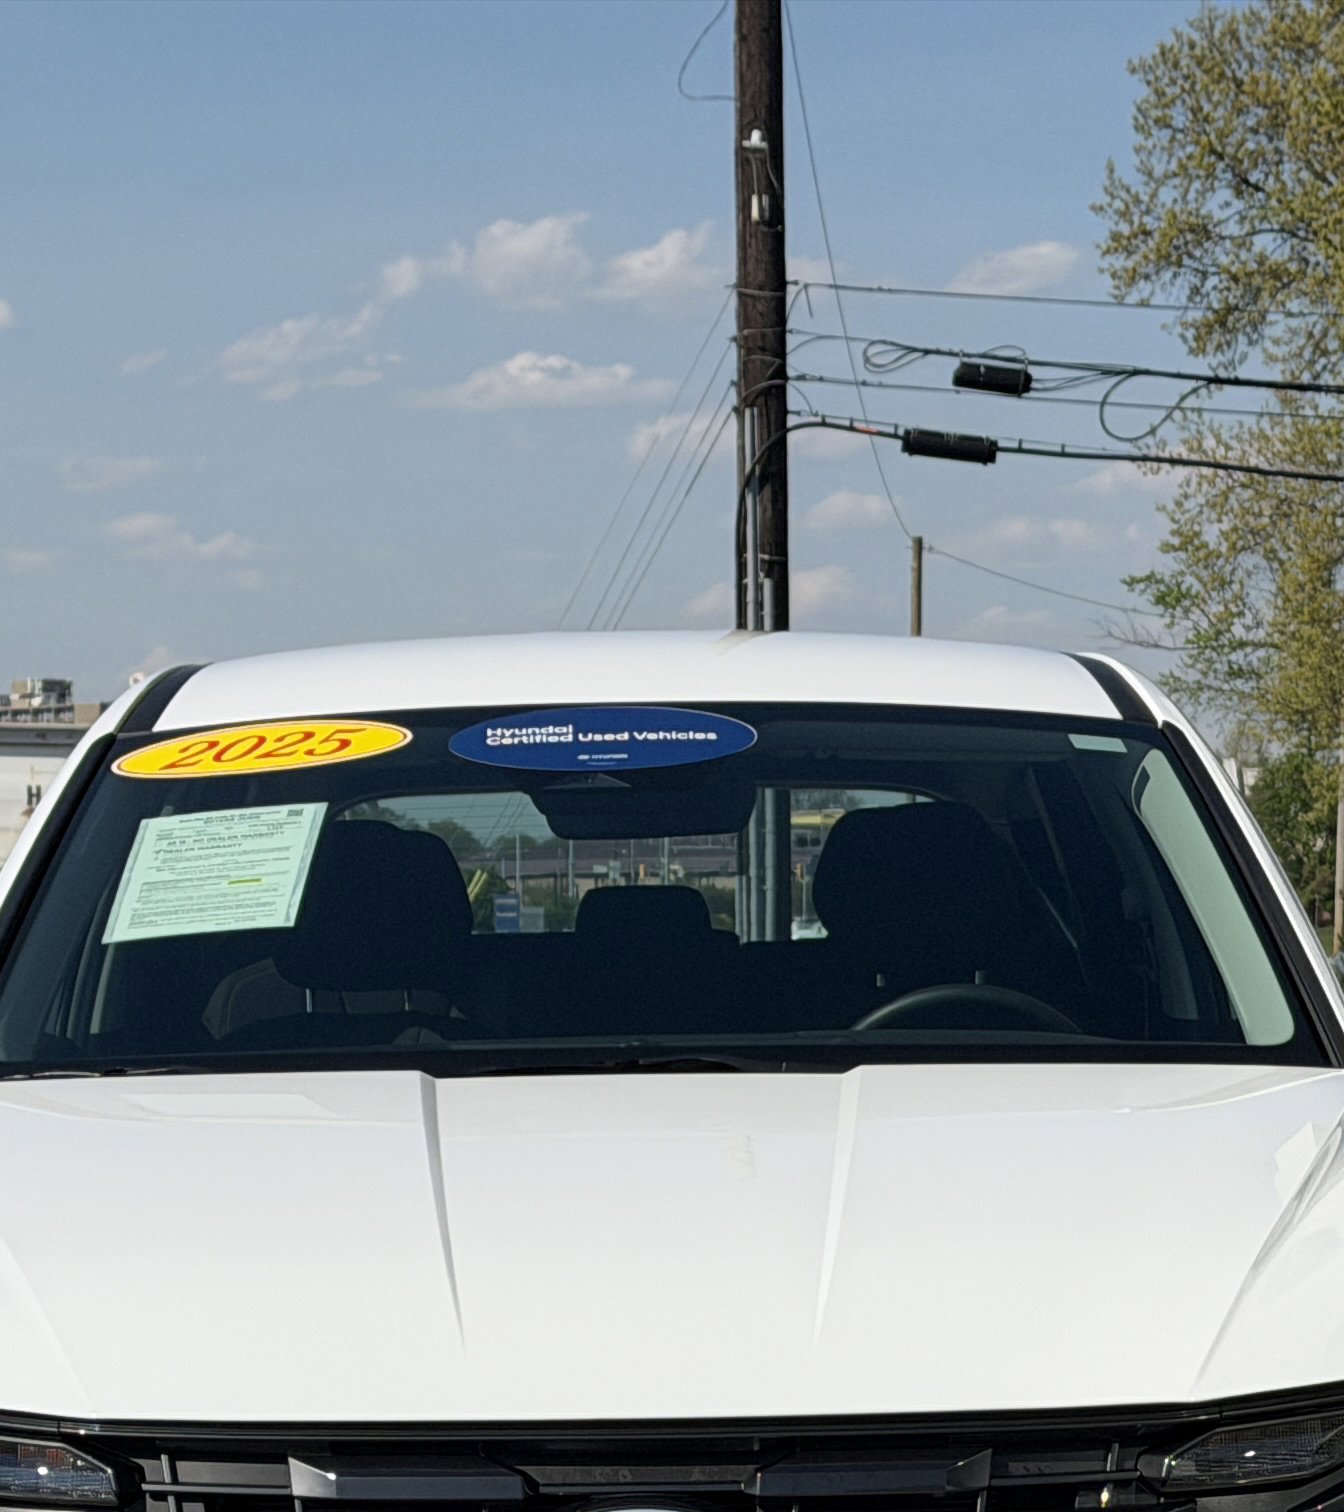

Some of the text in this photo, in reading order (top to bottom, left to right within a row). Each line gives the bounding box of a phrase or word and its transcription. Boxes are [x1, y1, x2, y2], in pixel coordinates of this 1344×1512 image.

[486, 724, 573, 738] Hyundai
[486, 730, 717, 745] Certified Used Vehicles
[159, 728, 367, 771] 2025
